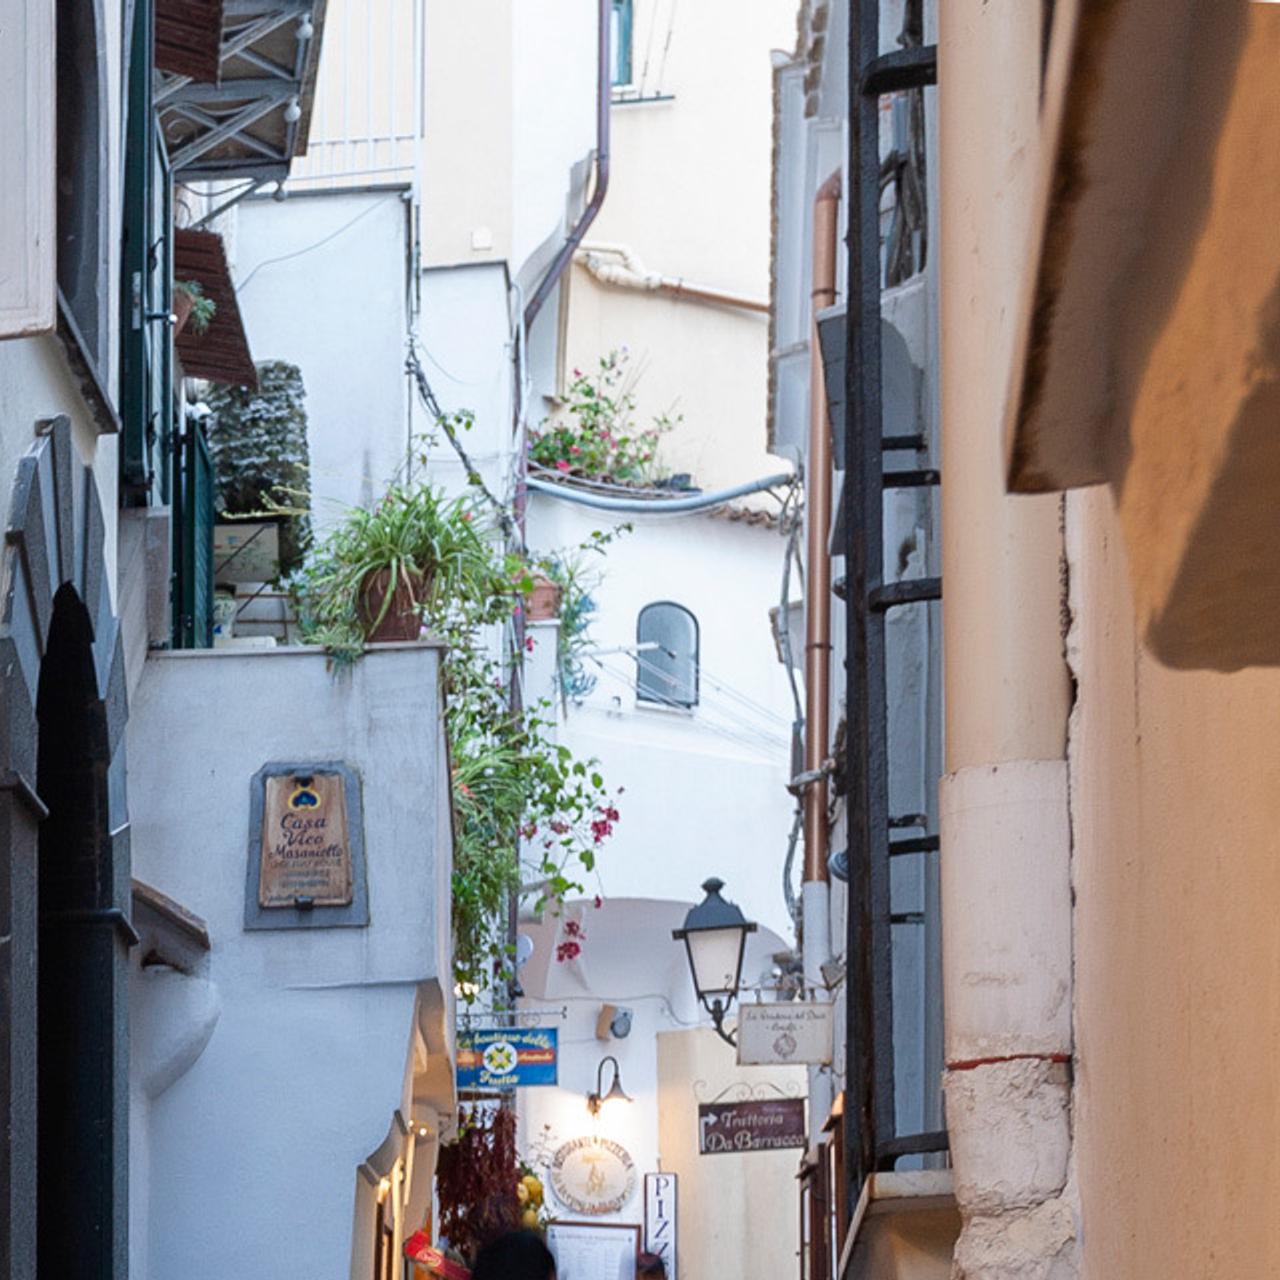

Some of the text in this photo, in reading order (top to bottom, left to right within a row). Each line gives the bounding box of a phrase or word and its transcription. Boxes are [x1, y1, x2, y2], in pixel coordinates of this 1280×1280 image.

[280, 812, 327, 832] Casa
[282, 828, 324, 847] Vico
[720, 1109, 784, 1129] Trattoria
[705, 1131, 734, 1152] Da
